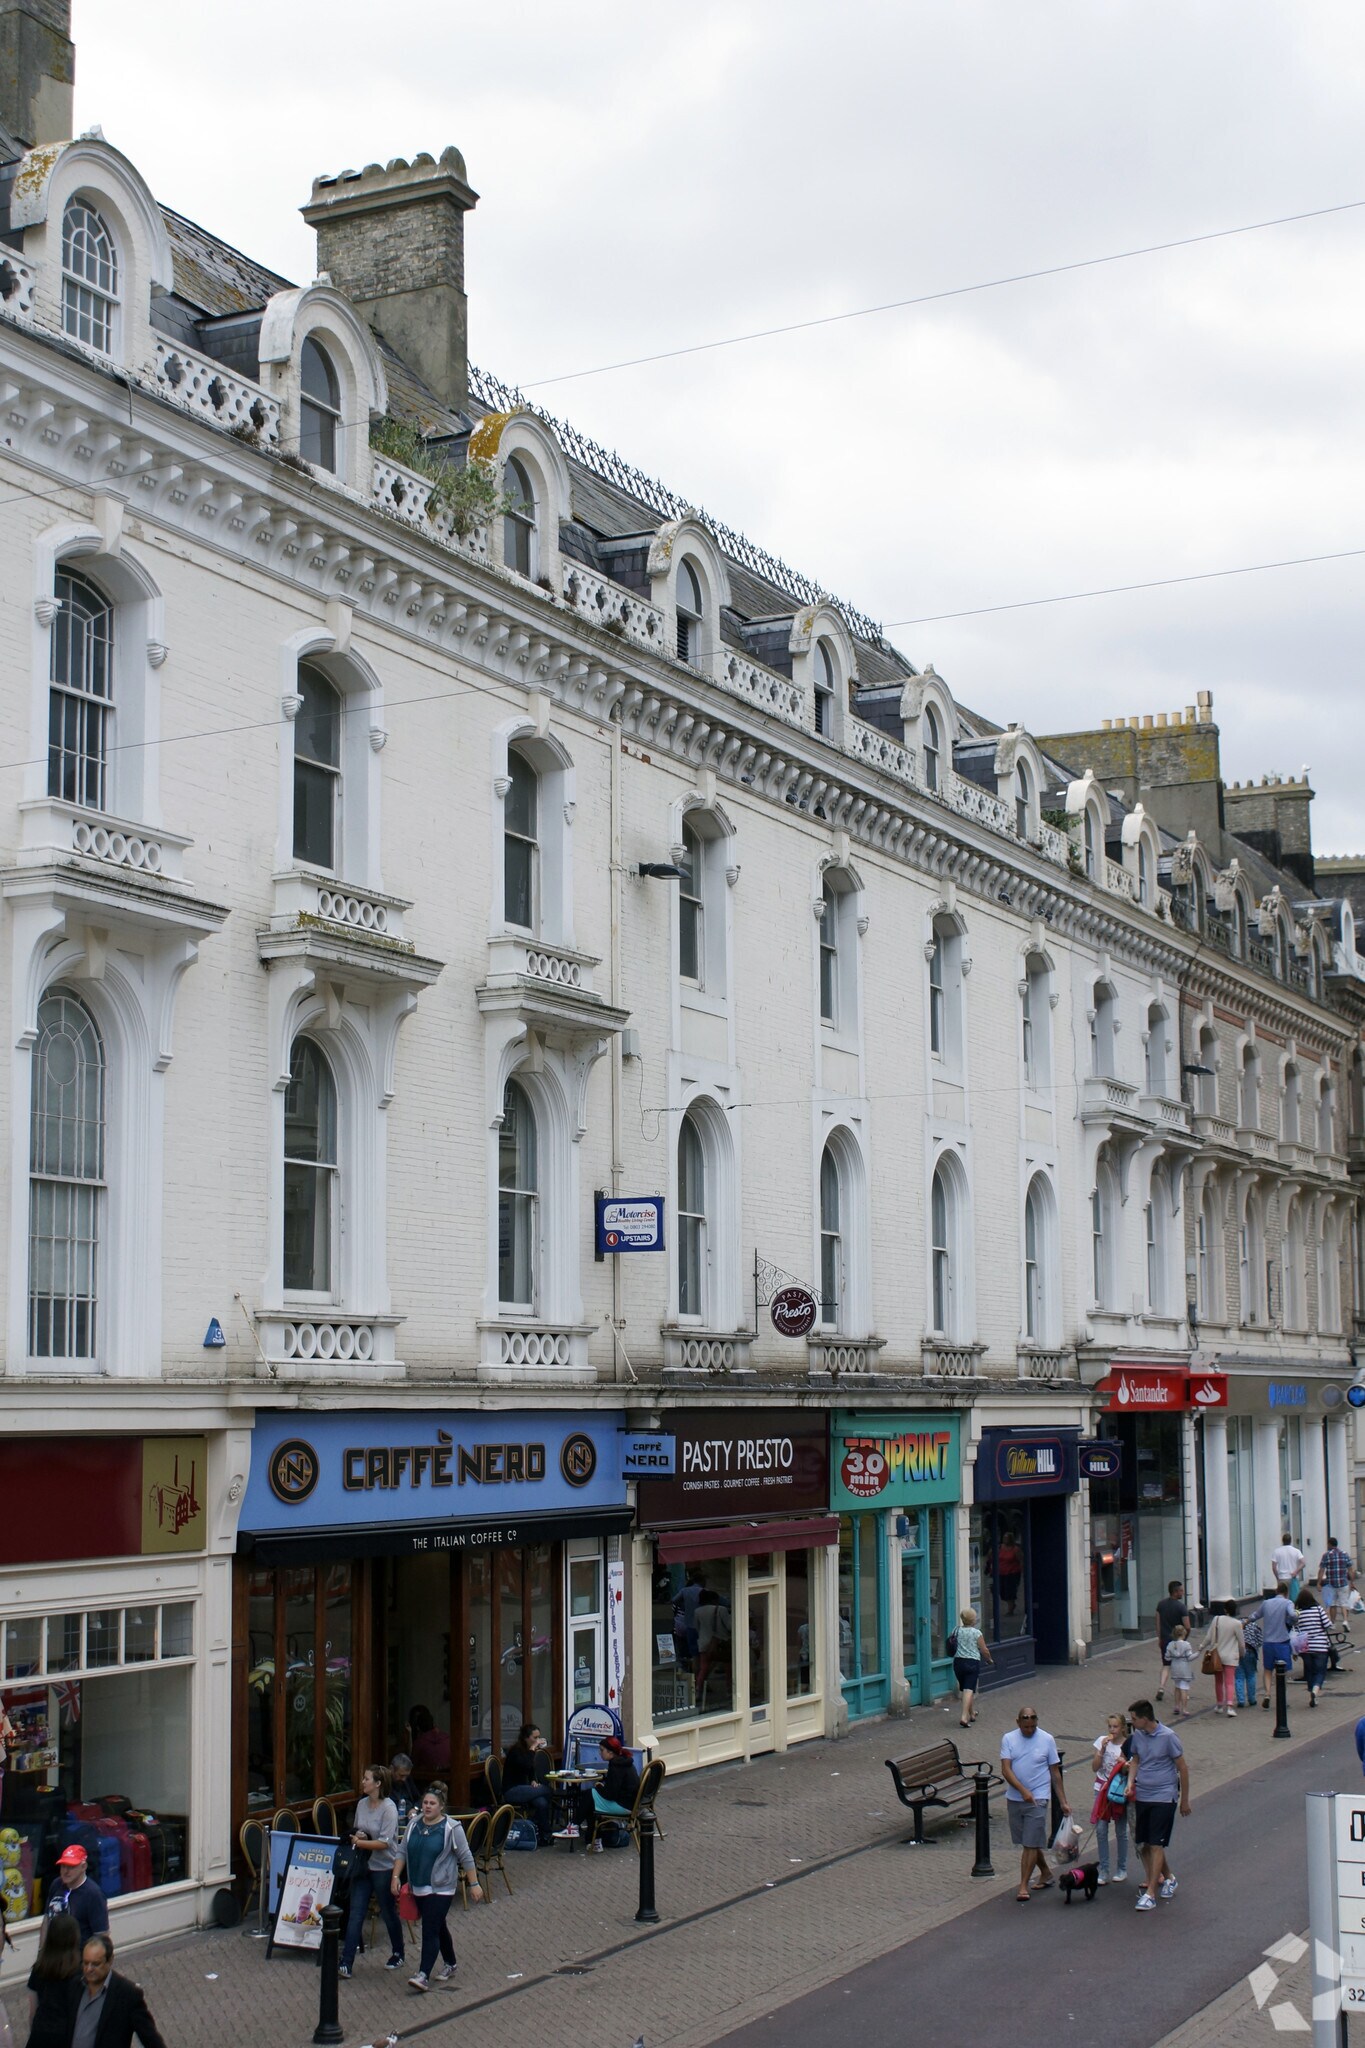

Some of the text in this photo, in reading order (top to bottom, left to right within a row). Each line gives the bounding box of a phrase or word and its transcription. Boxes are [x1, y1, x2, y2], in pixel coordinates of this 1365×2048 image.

[617, 1208, 656, 1219] Motorcise
[782, 1292, 807, 1301] PASTY
[772, 1302, 813, 1320] Presto
[1130, 1378, 1168, 1403] Santander
[633, 1441, 662, 1451] CAFFÈ
[343, 1429, 546, 1490] CAFFÈ NERO
[625, 1455, 669, 1466] NERO
[683, 1438, 793, 1473] PASTY PRESTO
[844, 1431, 950, 1482] TUPRINT
[1037, 1449, 1056, 1473] HILL
[846, 1452, 884, 1474] 30
[1090, 1461, 1110, 1471] HILL
[682, 1475, 793, 1491] CORNISH PASTIES GOURMET COFFEE FRESH PASTRIES
[850, 1472, 879, 1485] min
[847, 1484, 881, 1497] PHOTOS
[413, 1537, 428, 1549] THE
[434, 1534, 466, 1548] ITALIAN
[471, 1531, 502, 1544] COFFEE
[584, 1717, 612, 1730] Motorcise
[298, 1852, 332, 1864] NERO
[288, 1876, 332, 1889] BOOSTER
